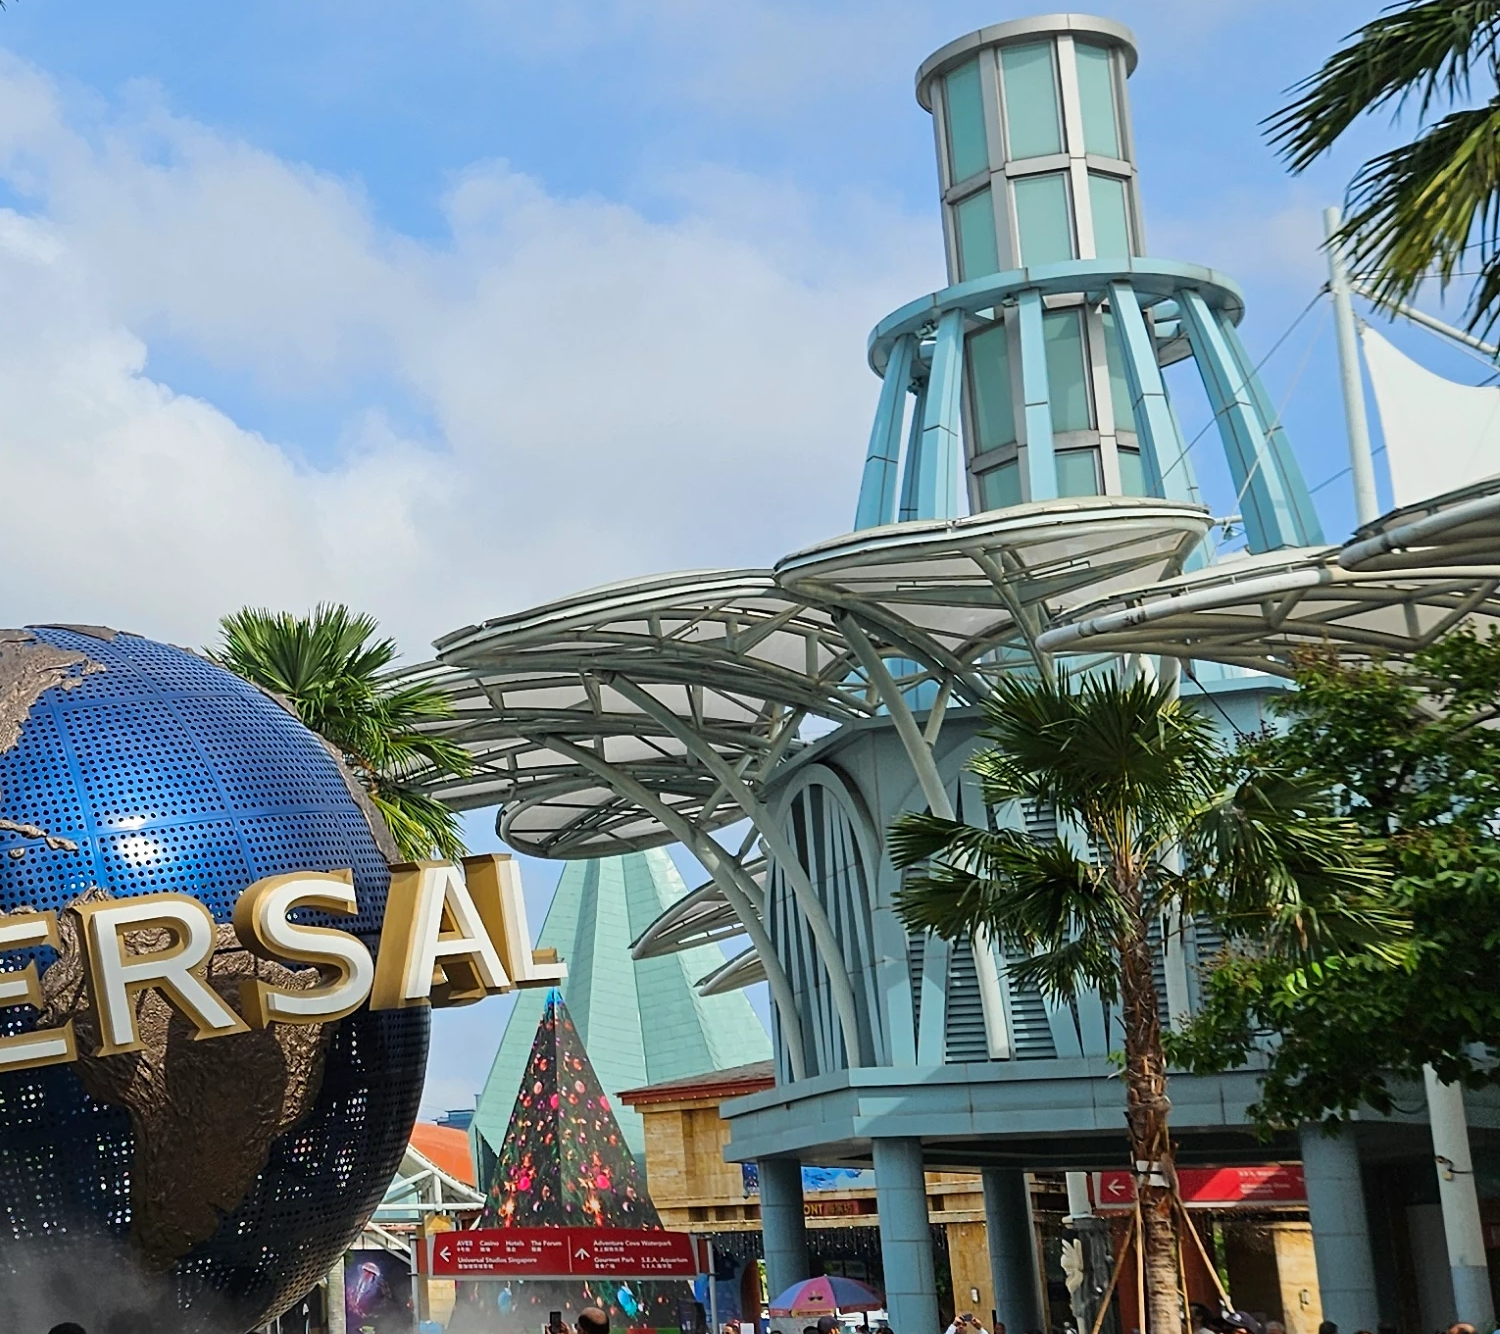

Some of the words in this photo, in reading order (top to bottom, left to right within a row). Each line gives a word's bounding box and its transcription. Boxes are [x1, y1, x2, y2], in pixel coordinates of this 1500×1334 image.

[641, 1240, 672, 1248] Waterpark
[508, 1257, 537, 1265] Singapore
[660, 1257, 688, 1265] Aquarium
